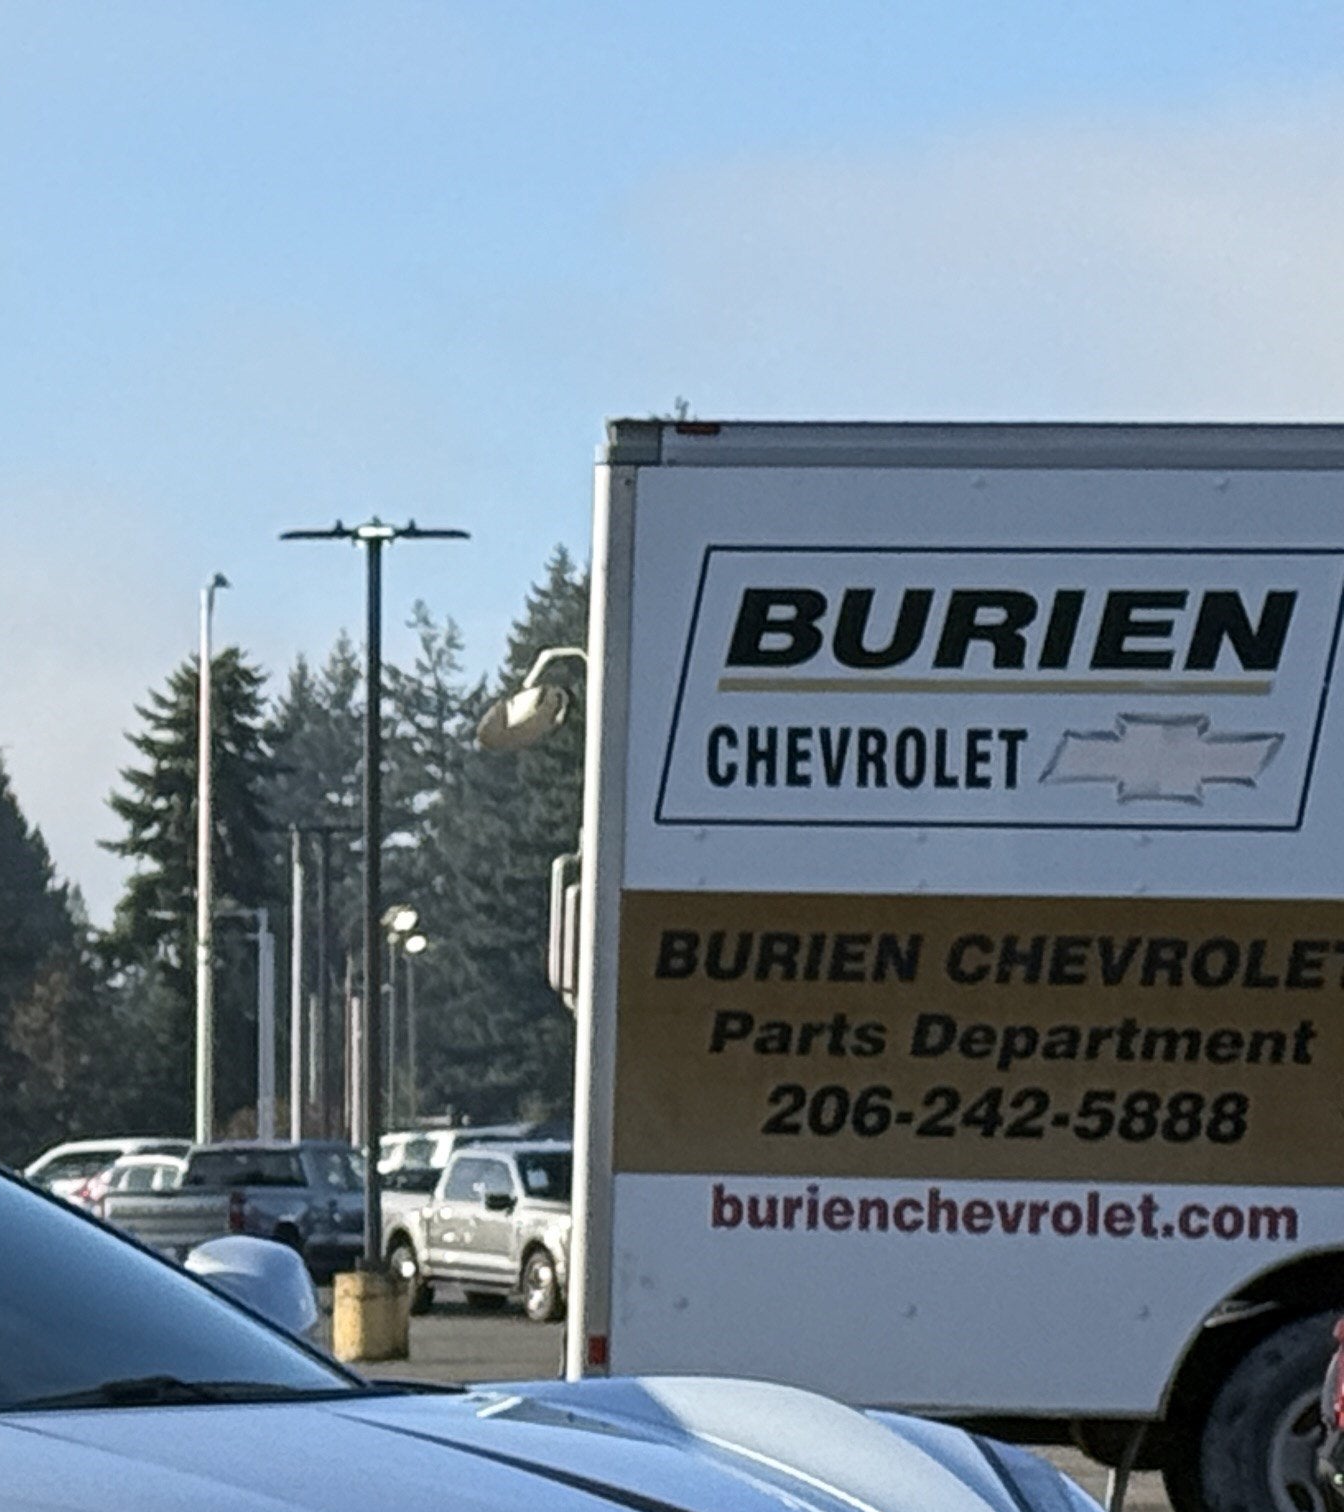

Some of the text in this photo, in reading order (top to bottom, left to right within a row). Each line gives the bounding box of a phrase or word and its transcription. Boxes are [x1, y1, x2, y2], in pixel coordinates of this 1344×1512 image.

[725, 587, 1300, 672] BURIEN
[706, 724, 1029, 790] CHEVROLET
[654, 928, 1344, 991] BURIEN CHEVROLE
[709, 1008, 1318, 1073] Parts Department
[761, 1083, 1250, 1145] 206-242-5888
[710, 1184, 1300, 1242] burienchevrolet.com
